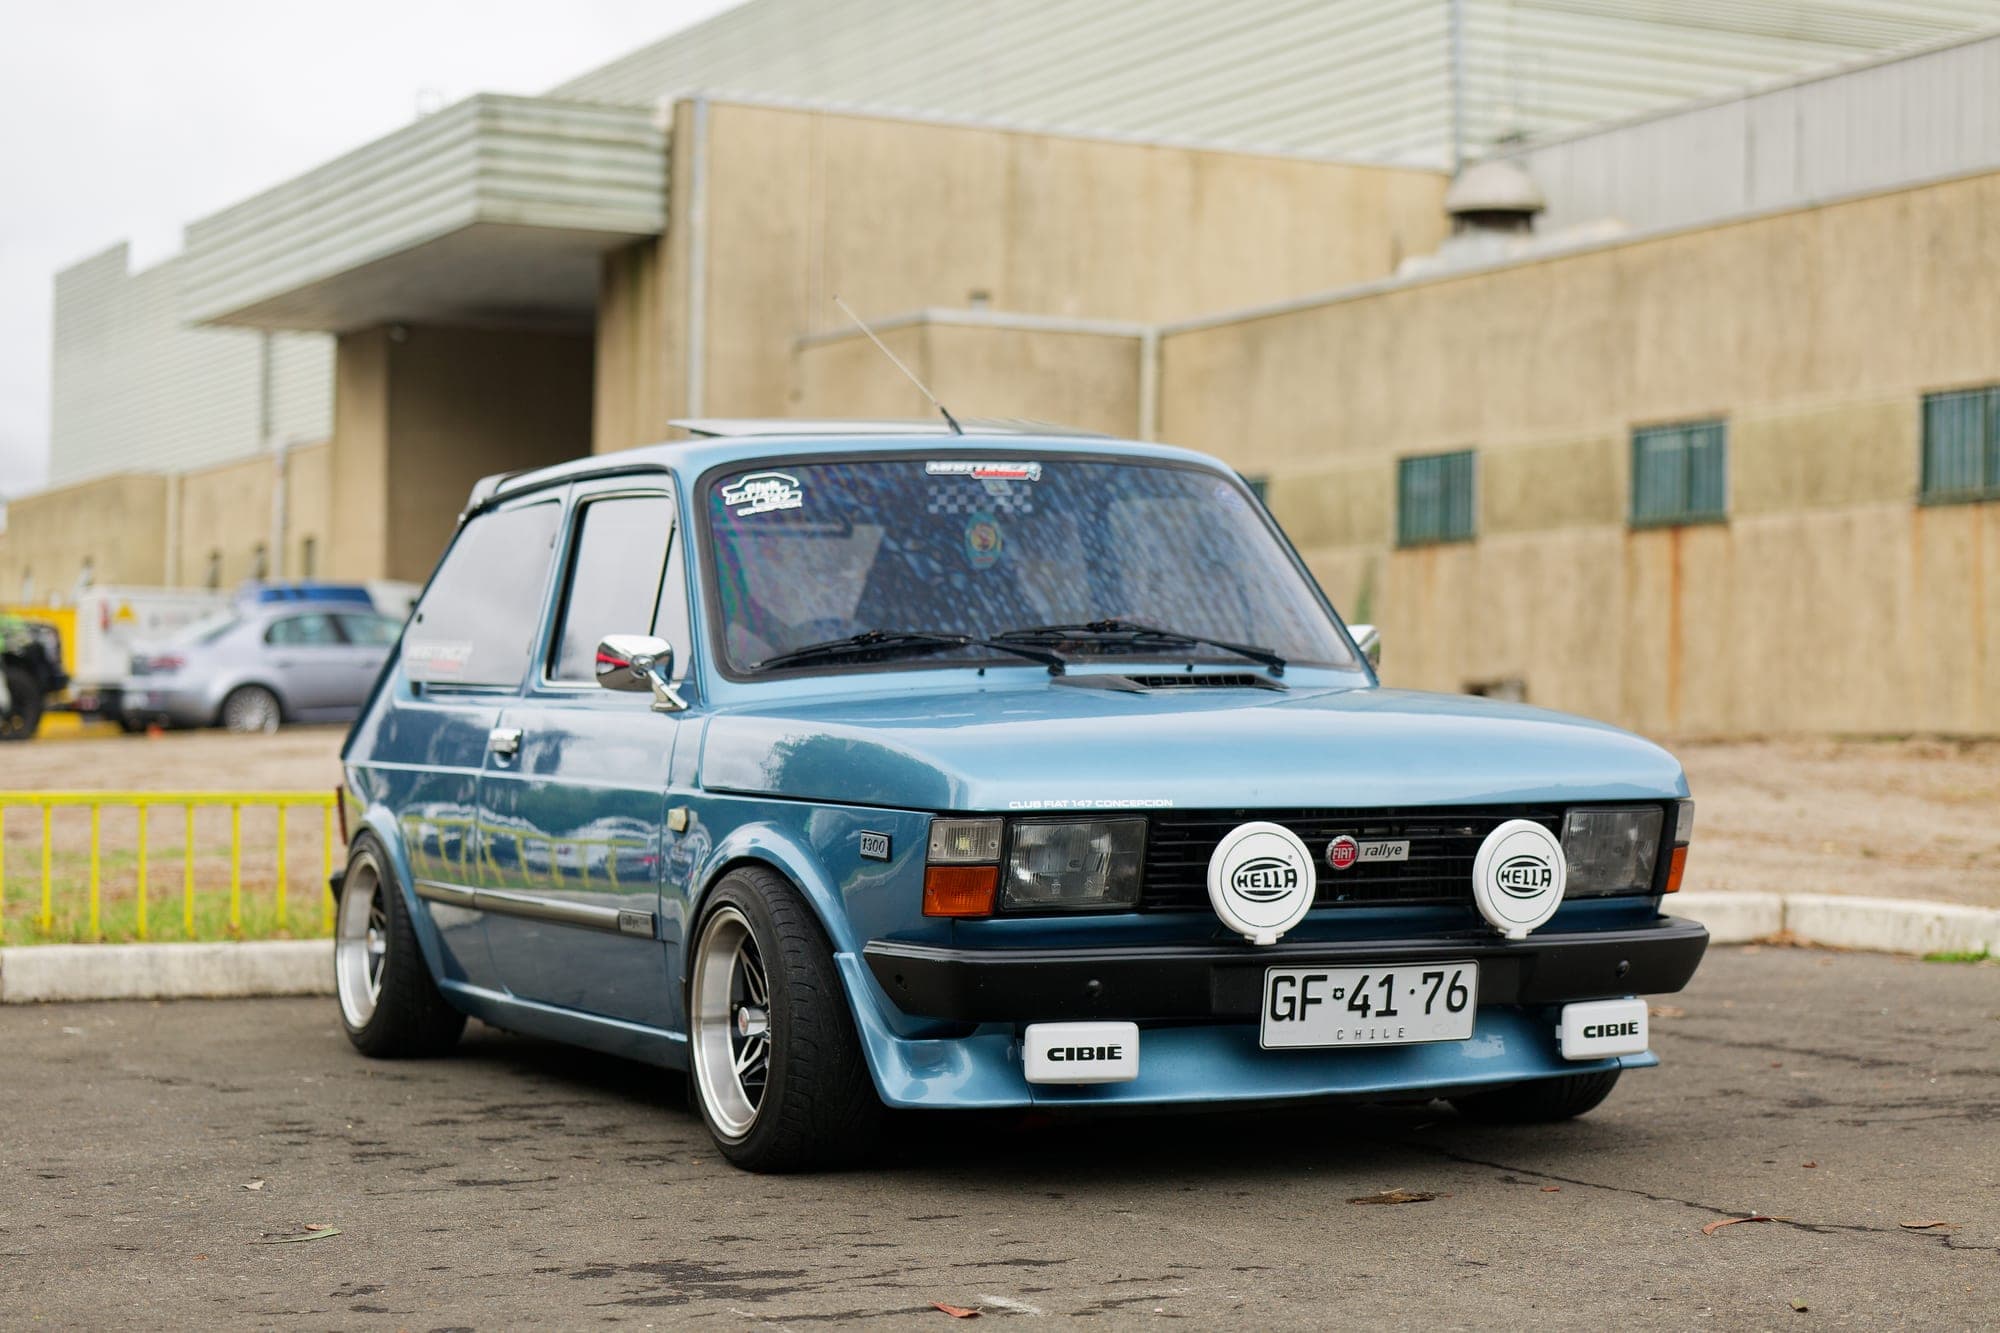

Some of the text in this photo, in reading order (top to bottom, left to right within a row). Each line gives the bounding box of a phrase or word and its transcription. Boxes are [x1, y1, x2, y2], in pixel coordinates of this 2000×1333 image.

[1009, 799, 1174, 809] CLUB FIAT 147 CONCEPCION
[862, 837, 886, 853] 1300
[1332, 844, 1402, 860] FIAT rallye
[1237, 868, 1298, 888] HELLA
[1501, 868, 1551, 888] HELLA
[1336, 1027, 1405, 1040] CHILE
